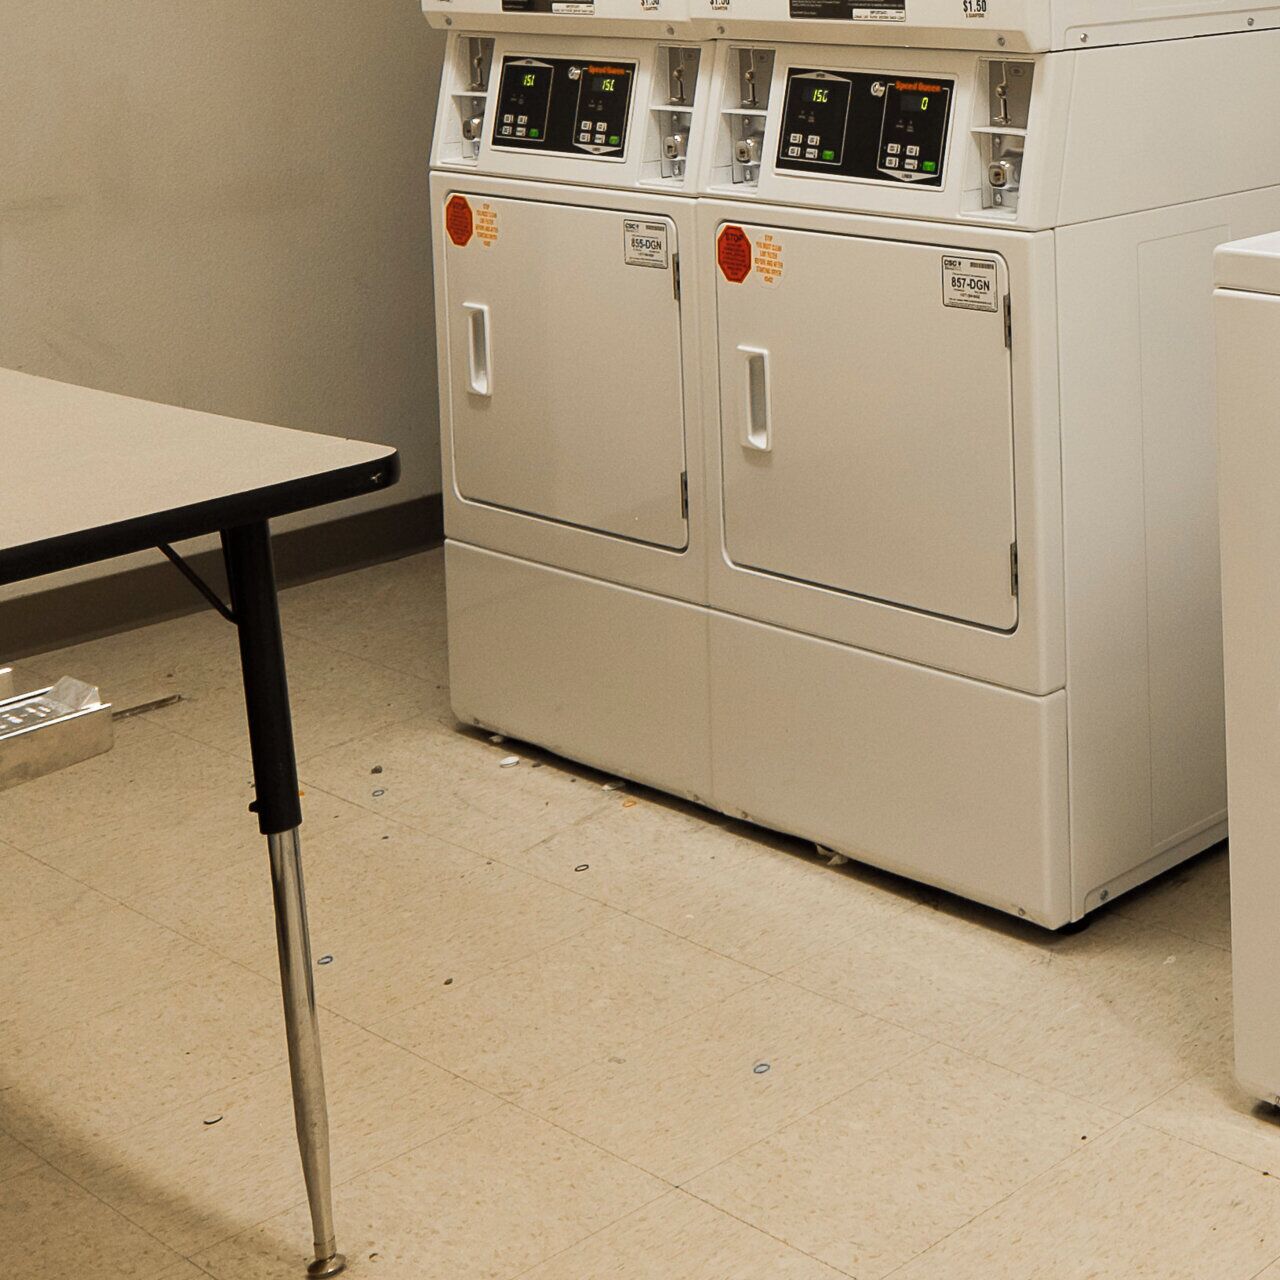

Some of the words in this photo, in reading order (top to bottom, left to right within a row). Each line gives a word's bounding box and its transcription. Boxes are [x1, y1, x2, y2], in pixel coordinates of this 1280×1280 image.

[963, 0, 986, 12] $1.50
[921, 97, 928, 110] 0
[630, 238, 662, 251] 855-DGN
[952, 277, 989, 291] 857-DGN
